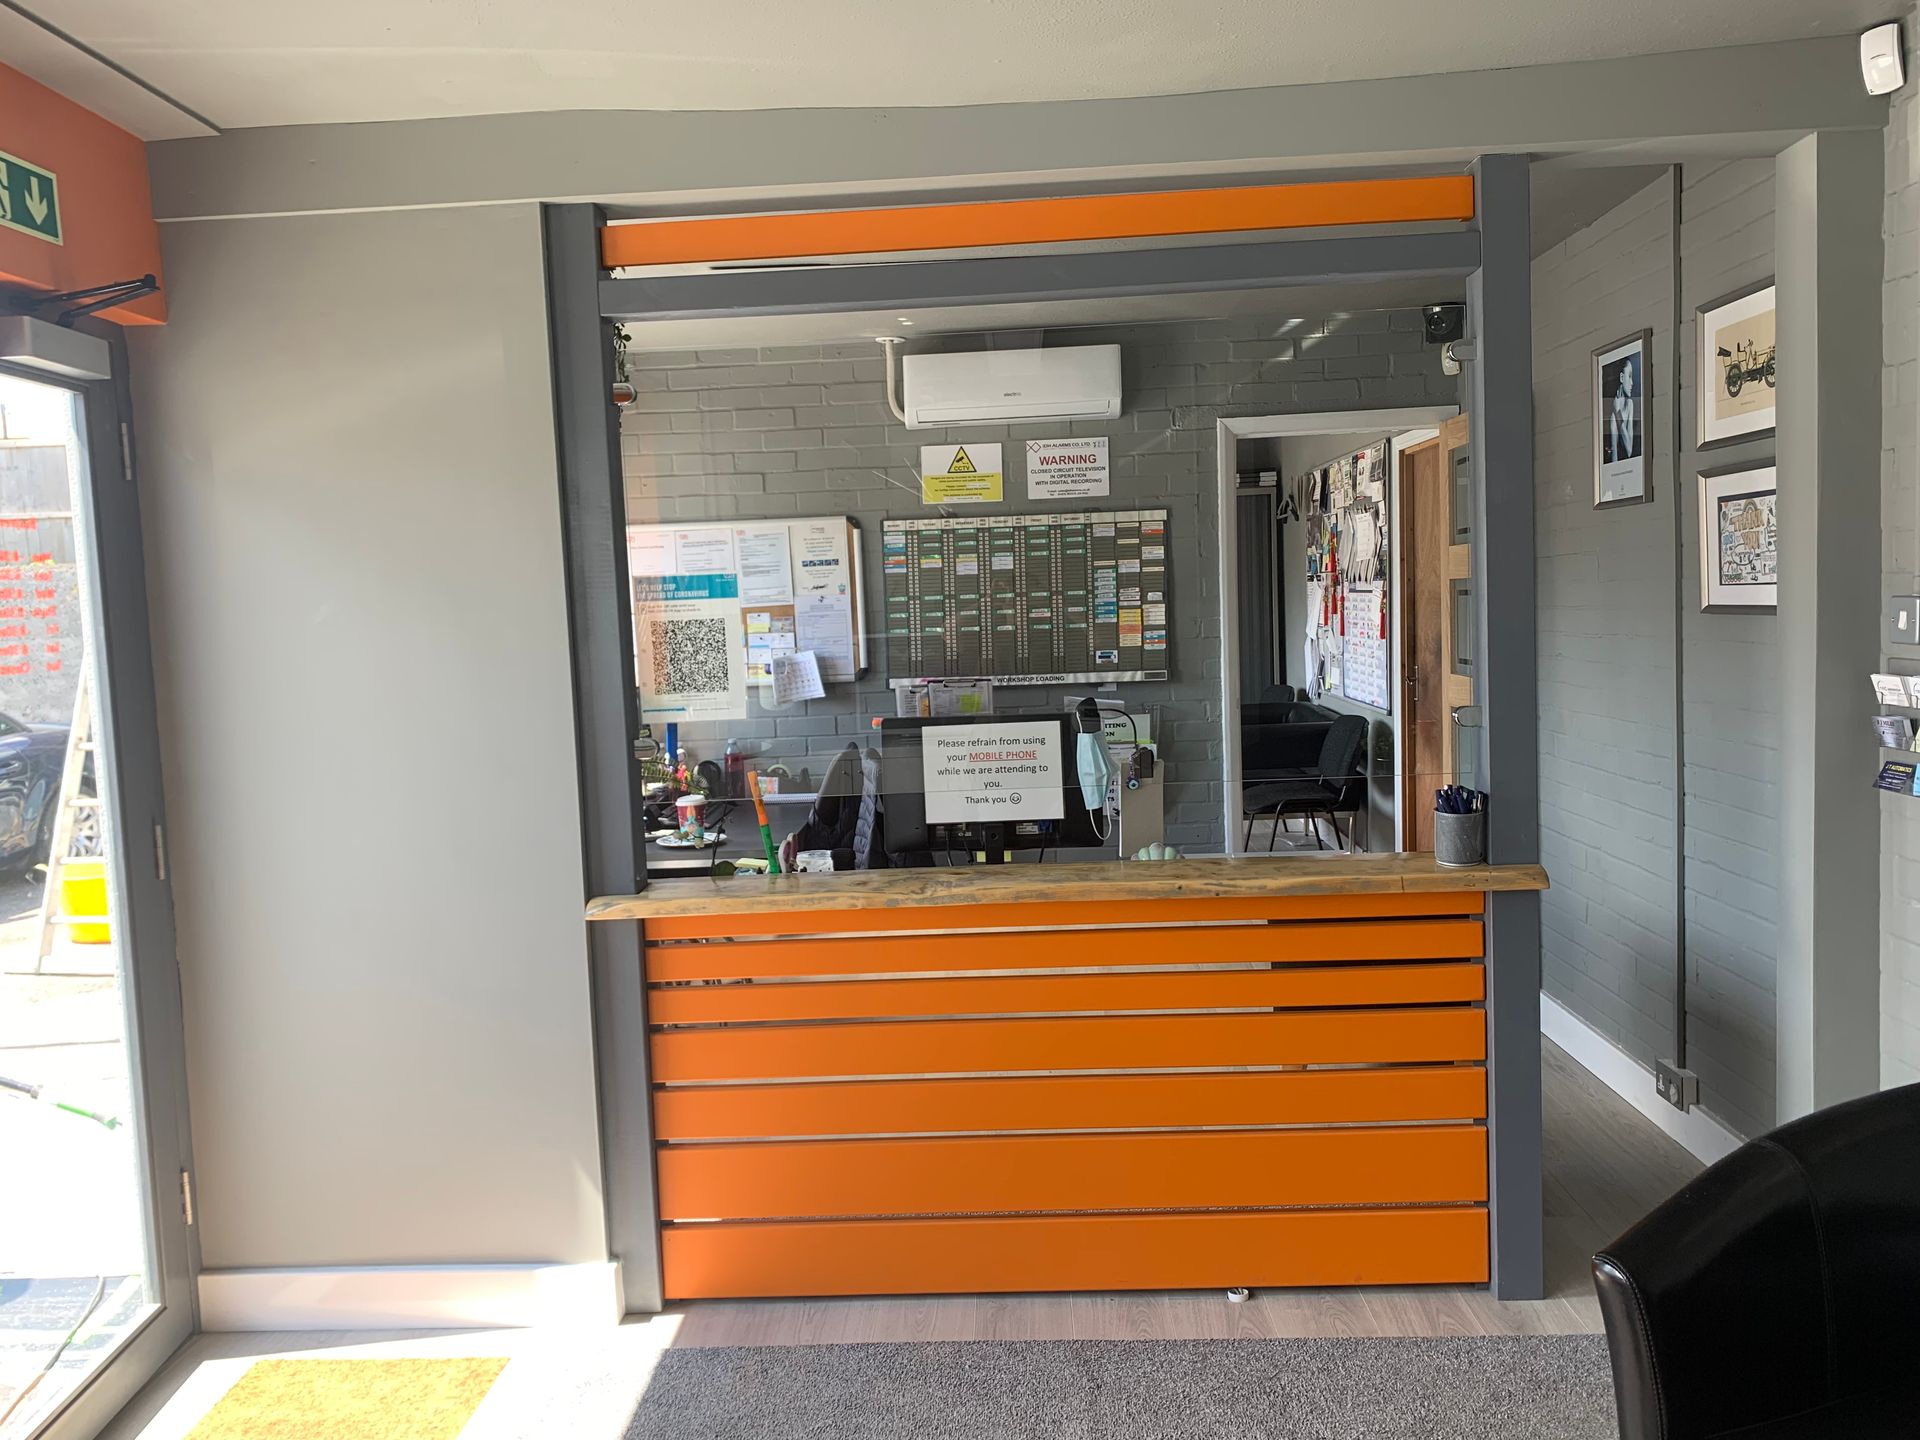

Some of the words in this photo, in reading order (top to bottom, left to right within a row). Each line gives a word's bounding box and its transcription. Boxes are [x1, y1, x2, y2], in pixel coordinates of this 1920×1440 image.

[1039, 453, 1097, 466] WARNING
[663, 583, 676, 591] STOP
[937, 739, 966, 748] Please
[967, 737, 997, 747] refrain
[999, 736, 1021, 746] from
[1022, 736, 1046, 746] using
[947, 753, 967, 763] your
[969, 751, 1003, 761] MOBILE
[1005, 750, 1037, 760] PHONE
[937, 766, 961, 776] while
[978, 767, 992, 775] are
[994, 764, 1037, 774] attending
[1039, 764, 1048, 772] to
[983, 781, 1003, 789] you.
[965, 796, 990, 804] Thank
[991, 797, 1007, 805] you
